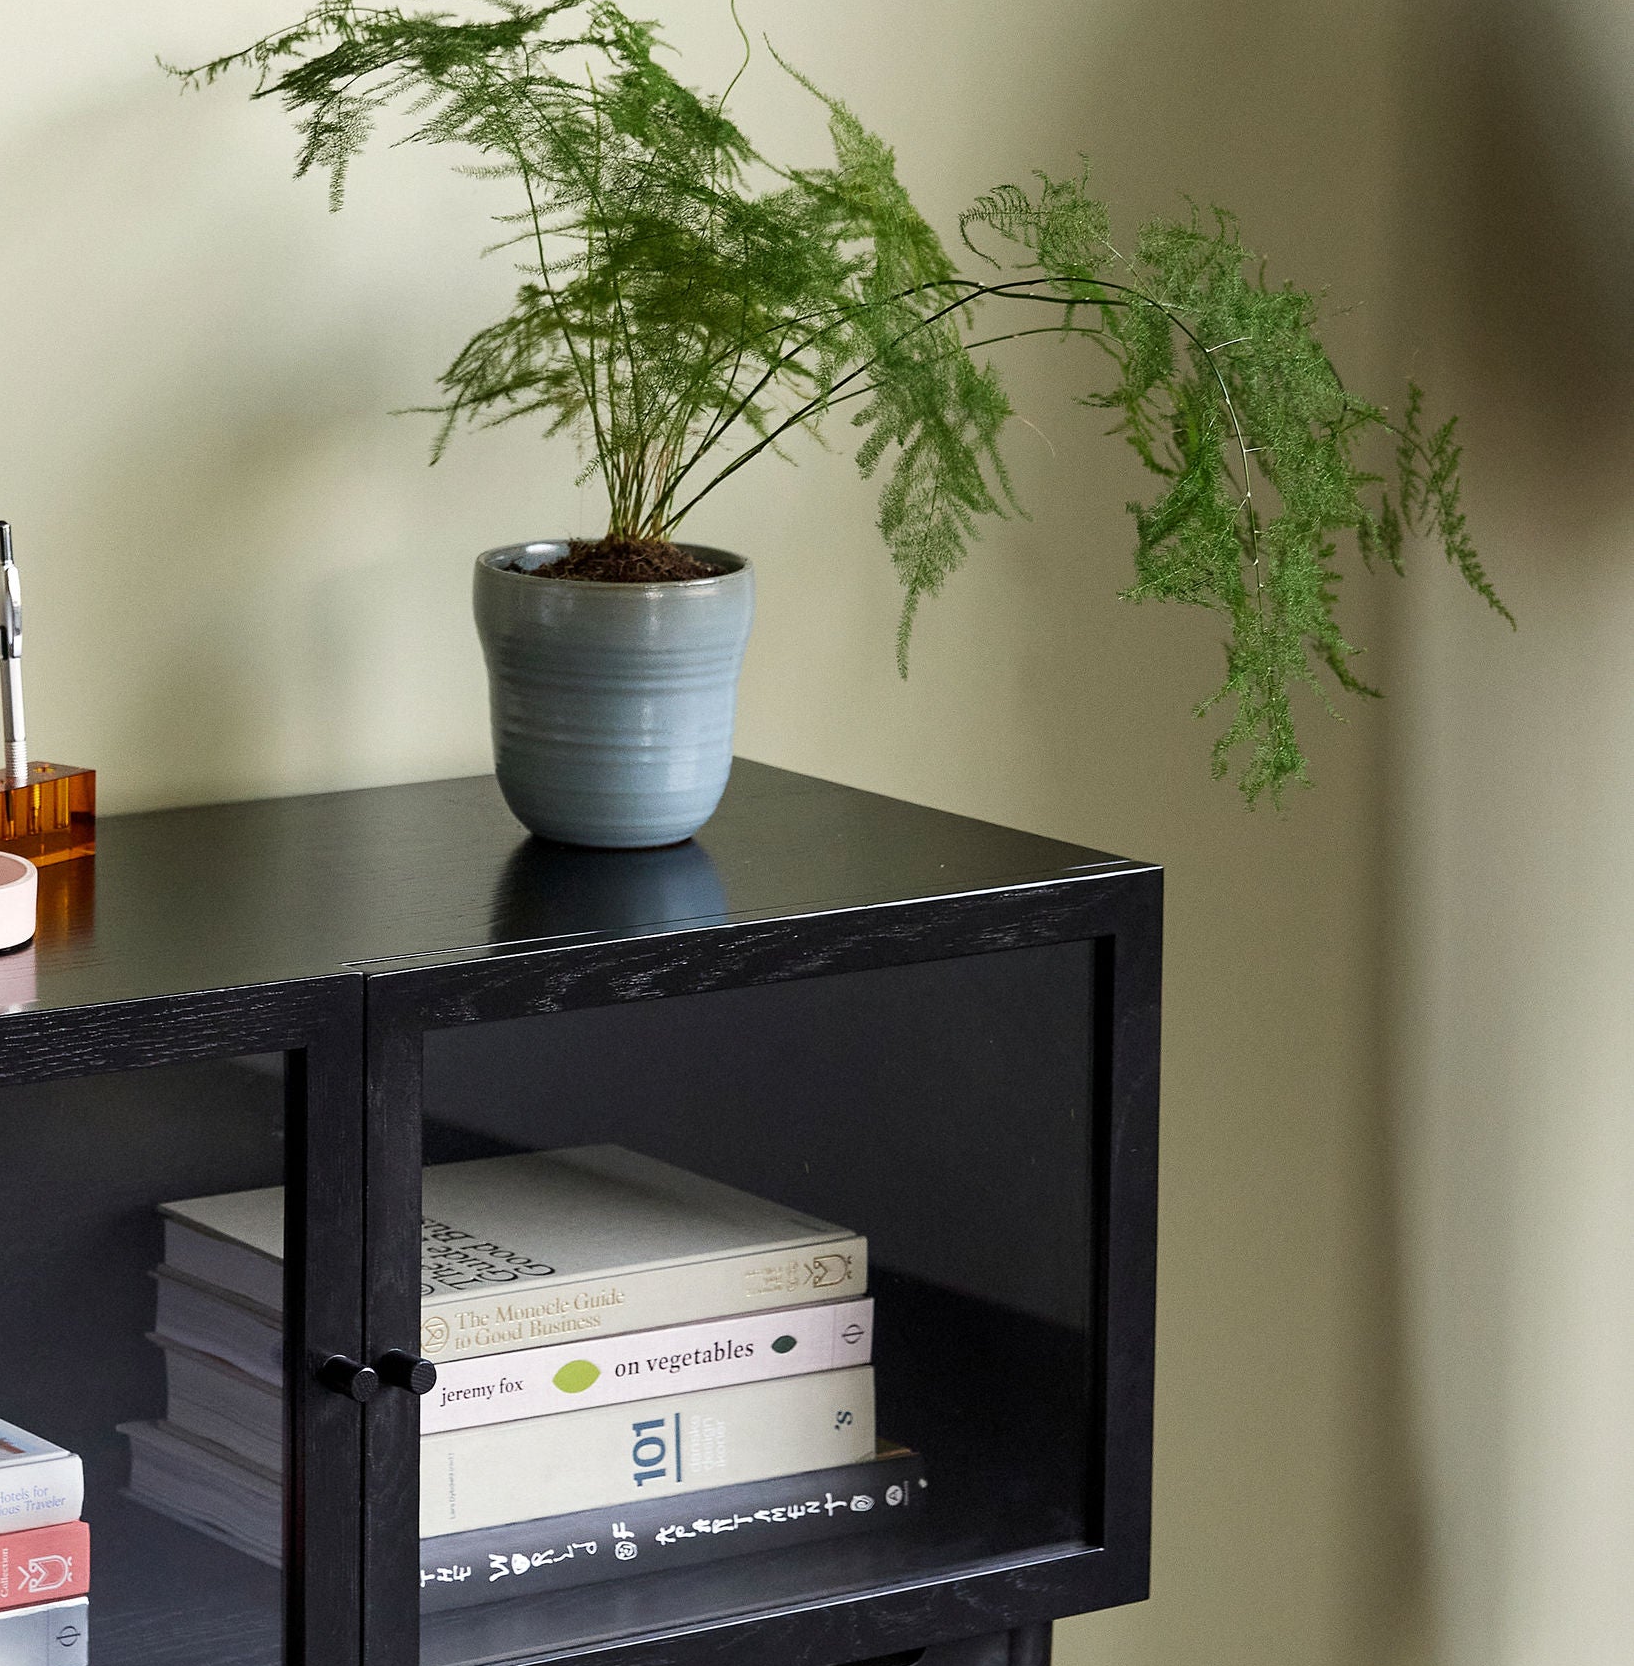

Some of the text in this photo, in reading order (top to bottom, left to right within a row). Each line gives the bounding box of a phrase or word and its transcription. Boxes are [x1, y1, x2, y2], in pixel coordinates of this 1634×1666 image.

[427, 1246, 518, 1281] Guide
[461, 1242, 555, 1276] Good
[455, 1288, 625, 1330] The Monocle Guide
[455, 1314, 602, 1350] to Good Business
[614, 1340, 754, 1377] on vegetables
[440, 1377, 524, 1407] jeremy fox
[632, 1418, 666, 1487] 101
[25, 1496, 66, 1511] Traveler
[34, 1485, 49, 1498] for
[420, 1565, 472, 1587] THE
